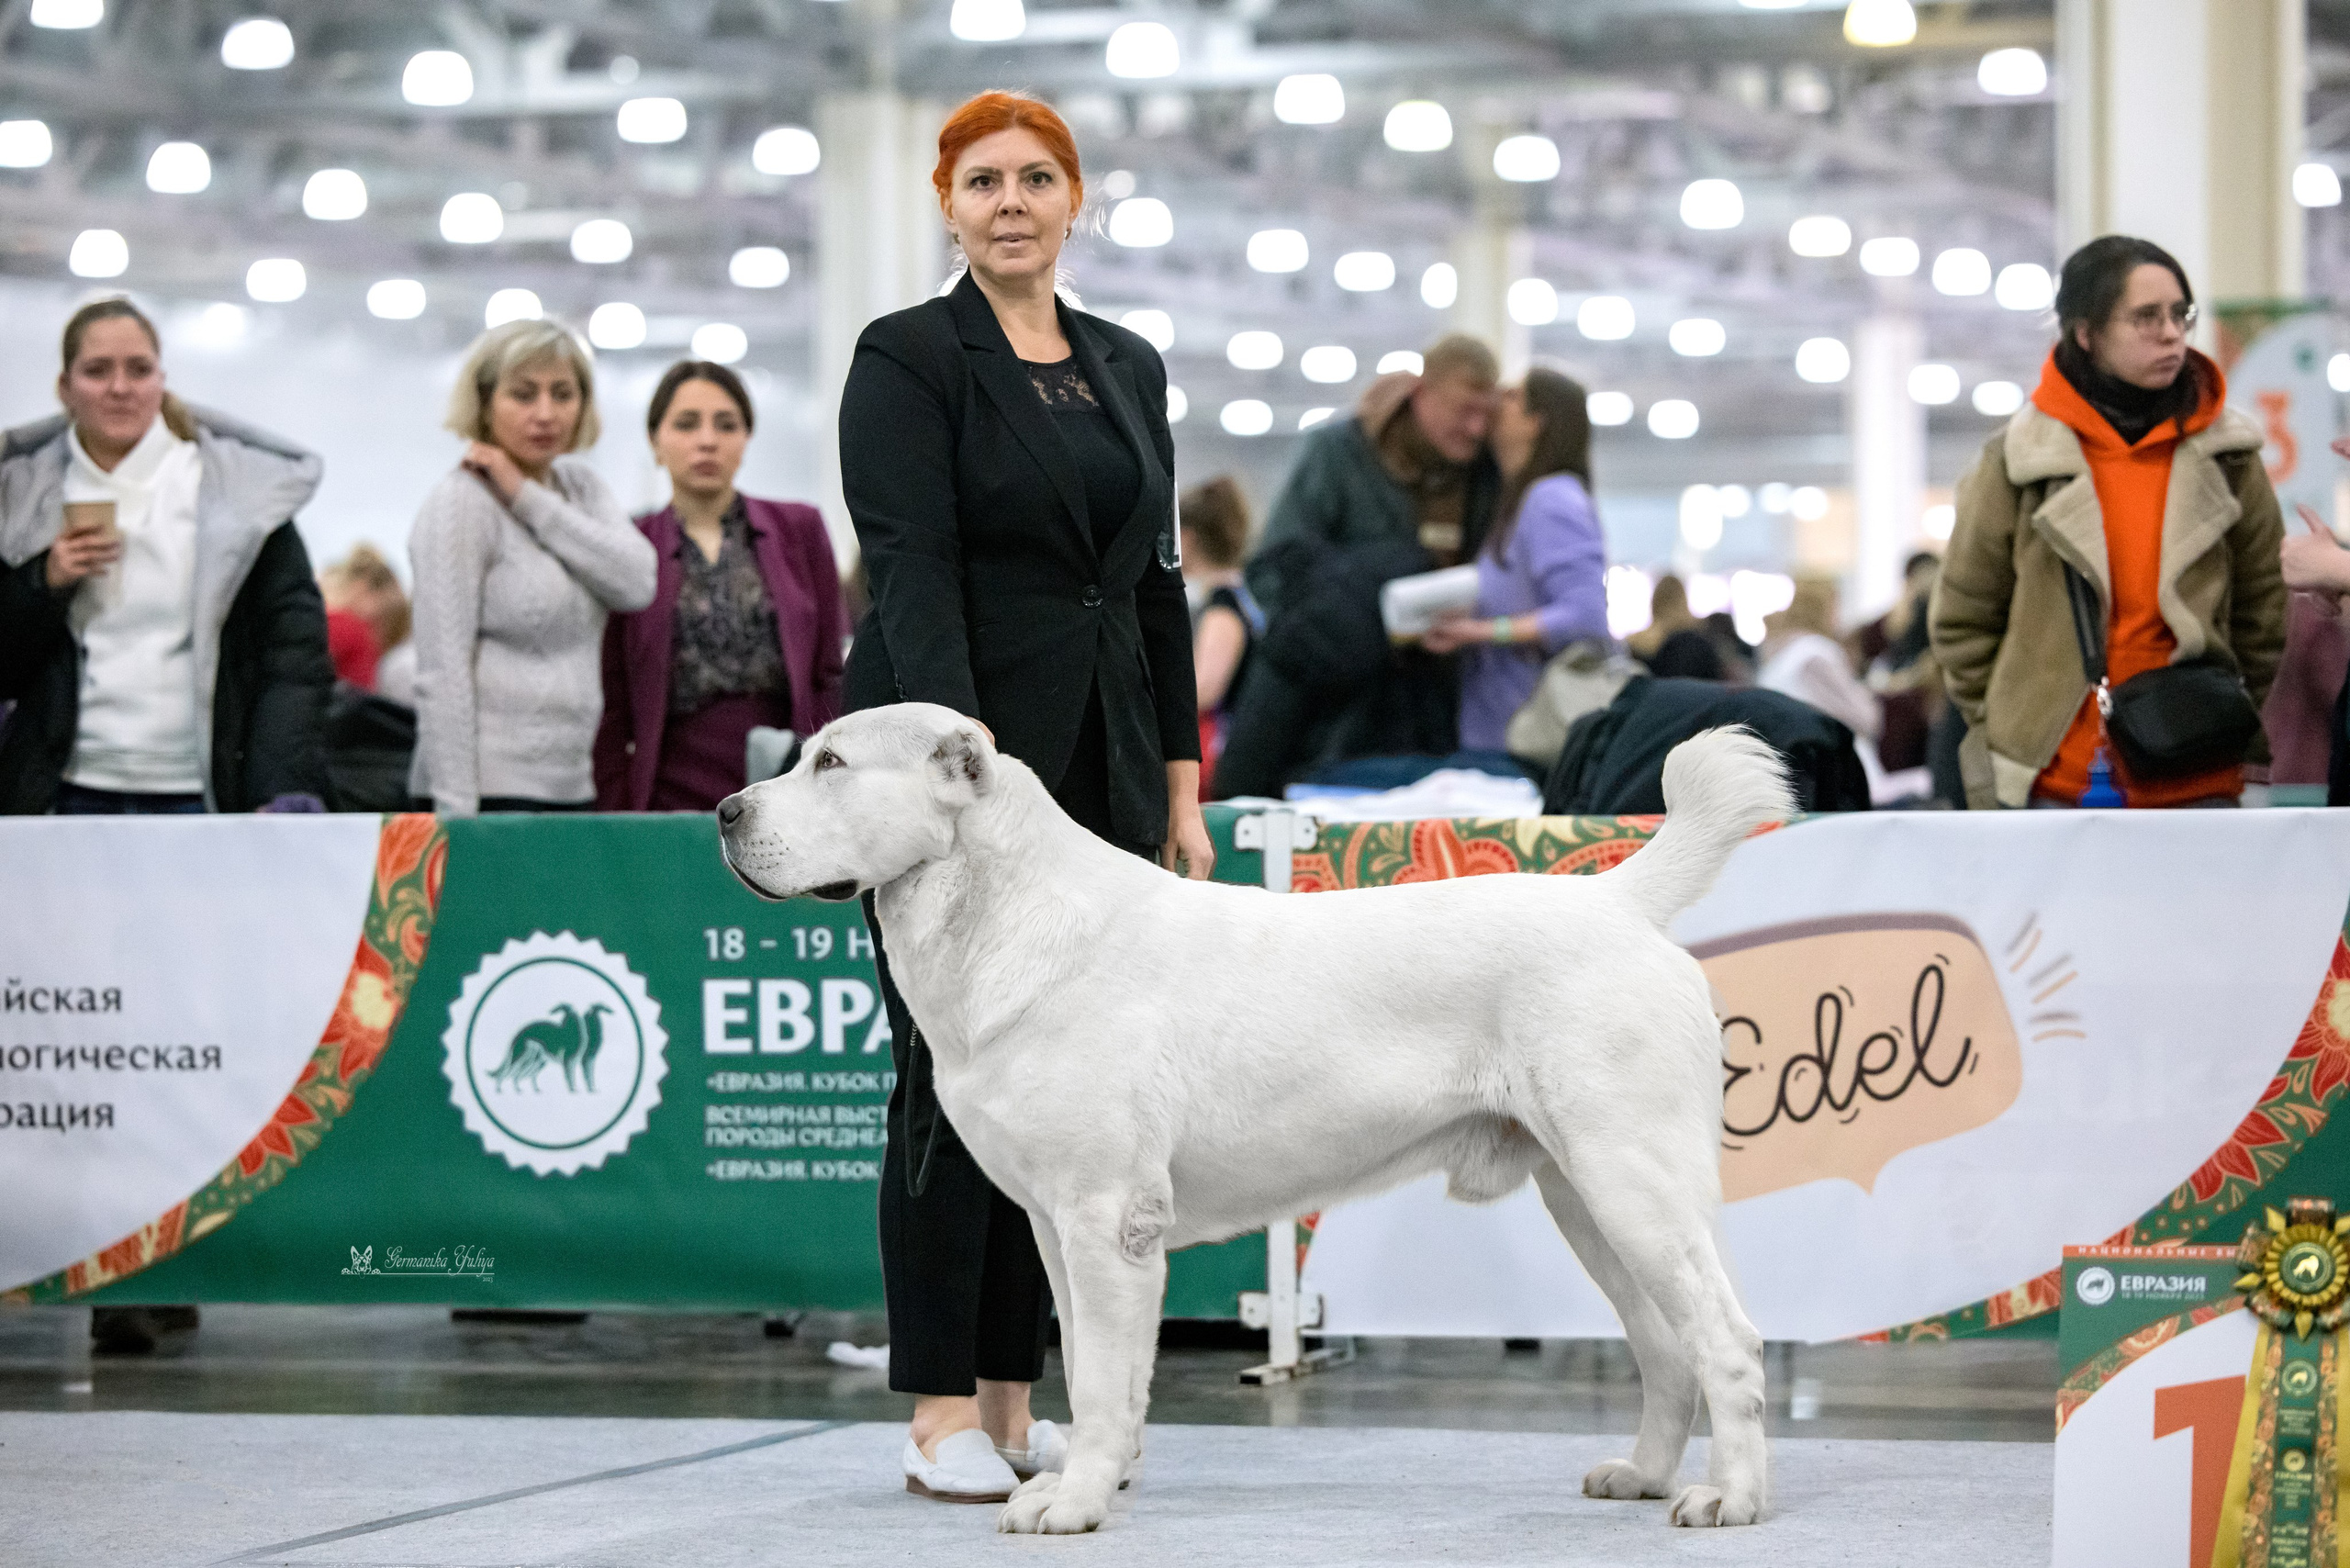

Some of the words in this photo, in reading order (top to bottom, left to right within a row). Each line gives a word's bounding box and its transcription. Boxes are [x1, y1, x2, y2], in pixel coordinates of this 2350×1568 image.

[703, 927, 745, 960] 18
[791, 927, 833, 960] 19
[4, 978, 122, 1013] йская
[0, 1044, 222, 1071] огическая
[811, 1072, 880, 1092] КУБОК
[705, 1106, 832, 1126] ВСЕМИРНАЯ
[705, 1127, 796, 1148] ПОРОДЫ
[811, 1160, 880, 1181] КУБОК
[2121, 1274, 2207, 1293] ЕВРАЗИЯ
